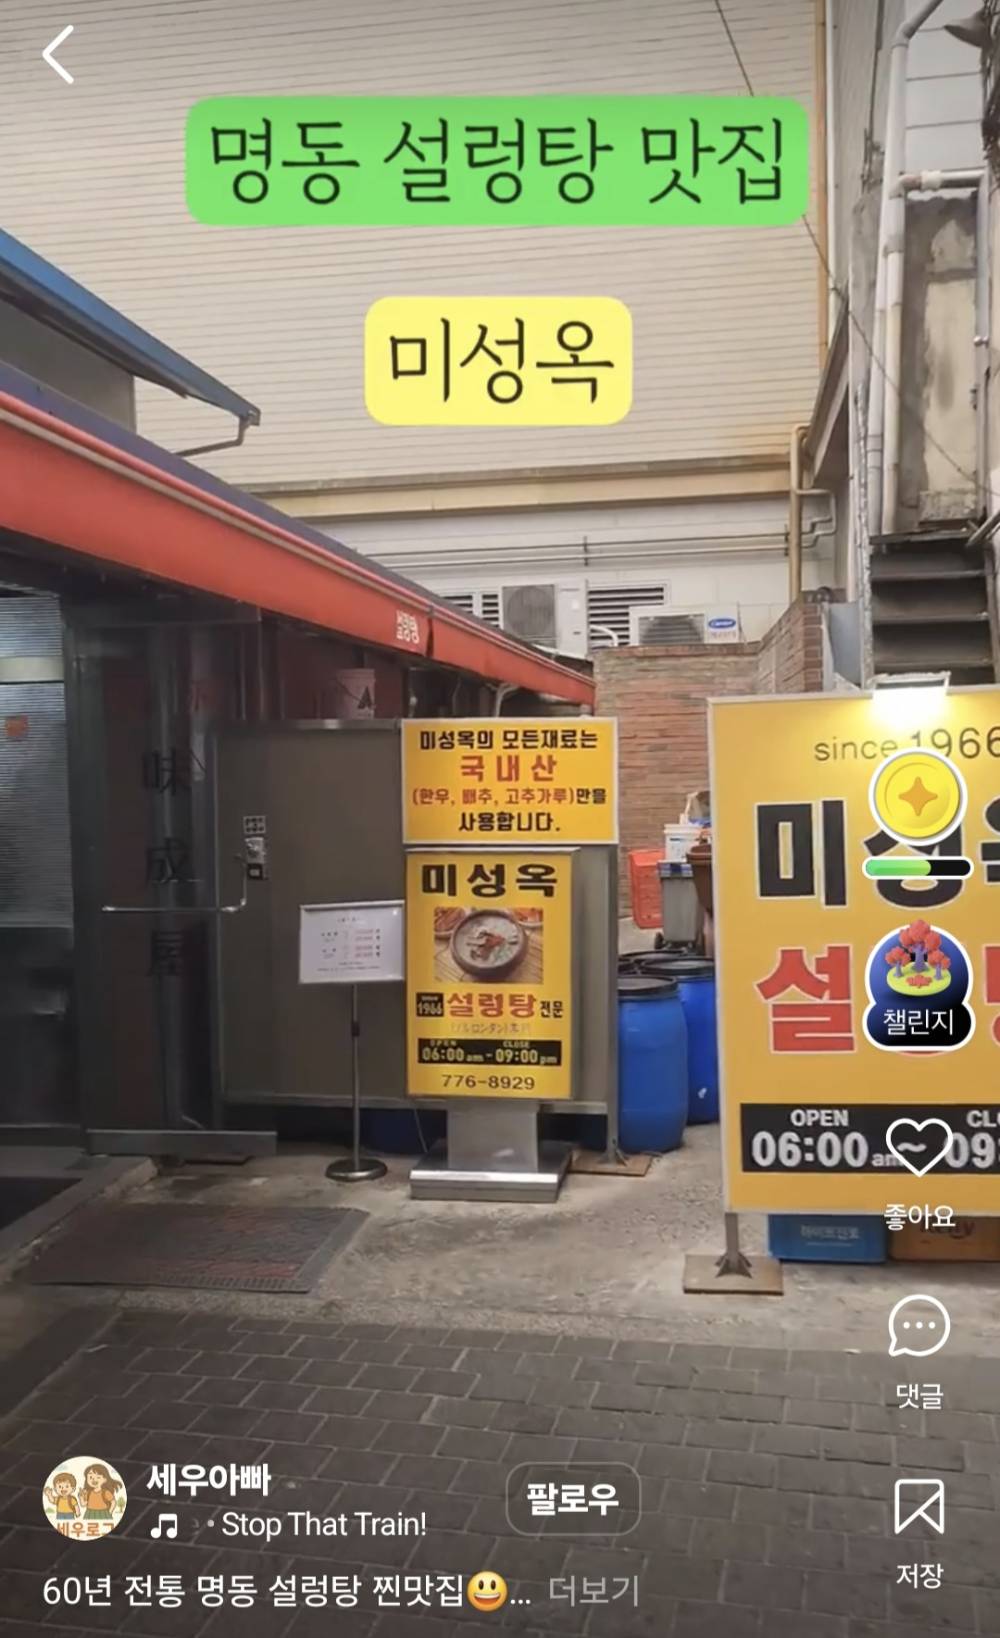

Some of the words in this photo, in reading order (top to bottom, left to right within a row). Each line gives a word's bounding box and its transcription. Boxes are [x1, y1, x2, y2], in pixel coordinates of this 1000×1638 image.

[420, 730, 494, 750] 미성옥의
[502, 729, 599, 749] 모든재료는
[814, 736, 898, 761] since
[412, 788, 455, 806] (한우,
[459, 811, 561, 832] 사용합니다.
[422, 863, 558, 898] 미성옥
[447, 992, 537, 1019] 설렁탕
[540, 1000, 564, 1018] 전문
[442, 1074, 535, 1090] 776-8929
[790, 1109, 849, 1128] OPEN
[966, 1109, 1000, 1128] CL
